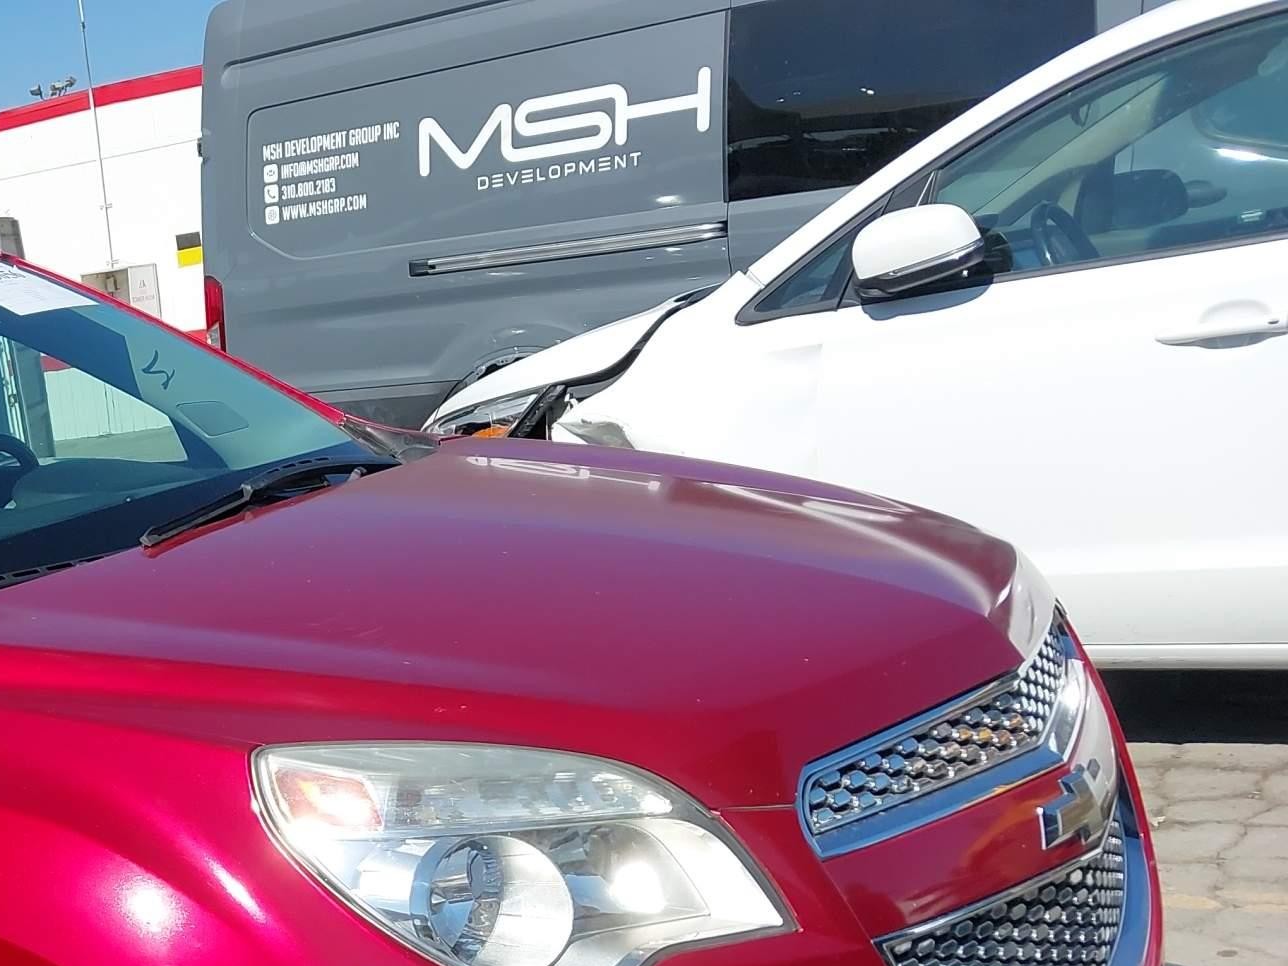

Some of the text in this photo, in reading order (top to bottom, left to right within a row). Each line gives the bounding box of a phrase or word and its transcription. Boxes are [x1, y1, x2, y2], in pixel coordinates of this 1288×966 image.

[419, 66, 711, 177] MSH
[263, 121, 400, 161] MSH DEVELOPMENT GROUP INC
[281, 152, 360, 179] INFO@MSHGRP.COM
[477, 151, 642, 191] DEVELOPMENT
[281, 178, 336, 200] 310.800.2183
[282, 194, 367, 221] WWW.MSHGRP.COM
